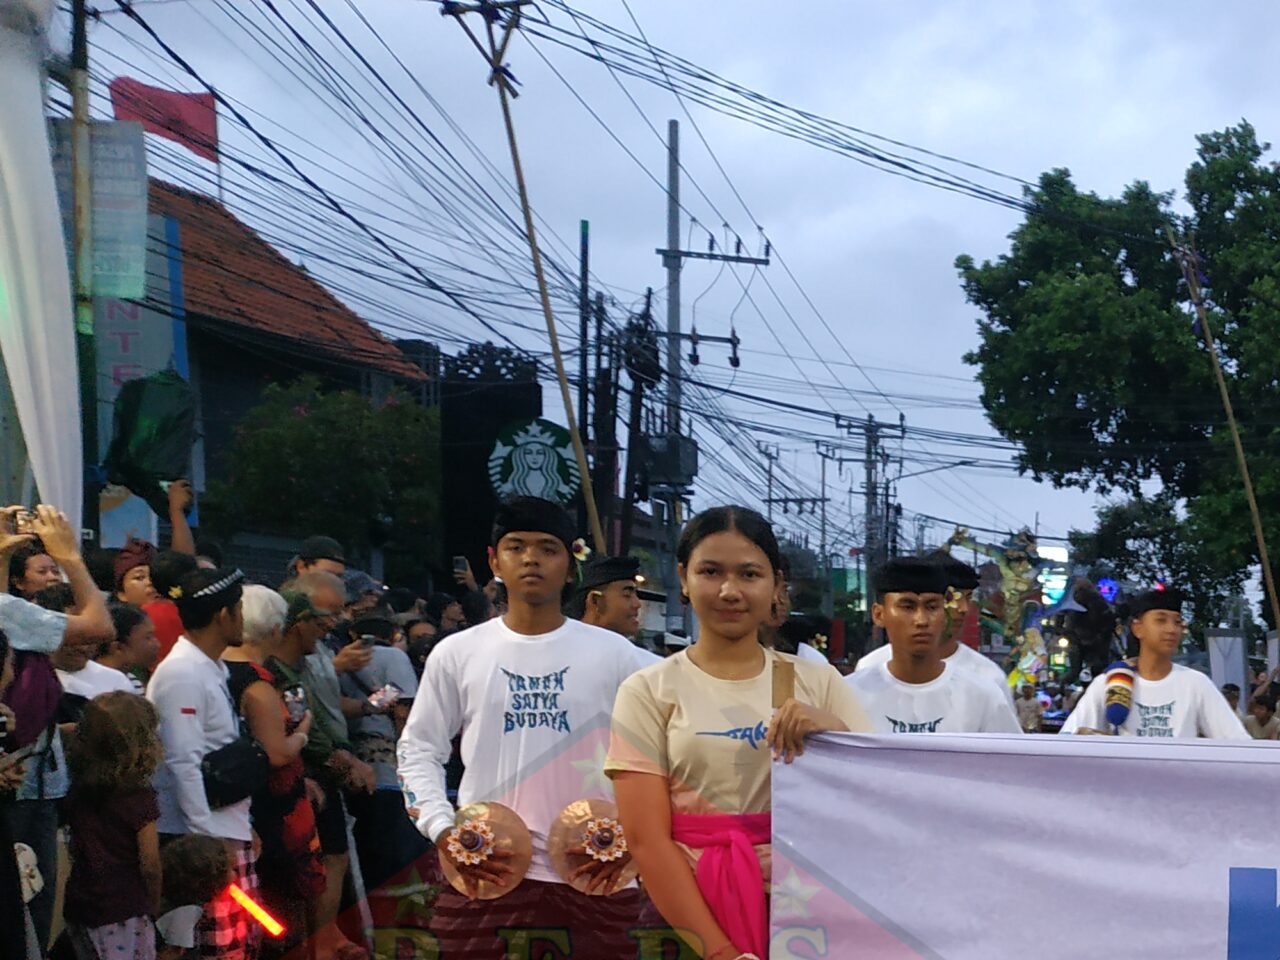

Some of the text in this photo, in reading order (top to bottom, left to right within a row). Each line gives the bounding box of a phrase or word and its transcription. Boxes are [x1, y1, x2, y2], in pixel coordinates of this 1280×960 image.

[500, 666, 570, 692] TAMAN
[511, 692, 560, 711] SATYA
[503, 710, 571, 735] BUDAYA
